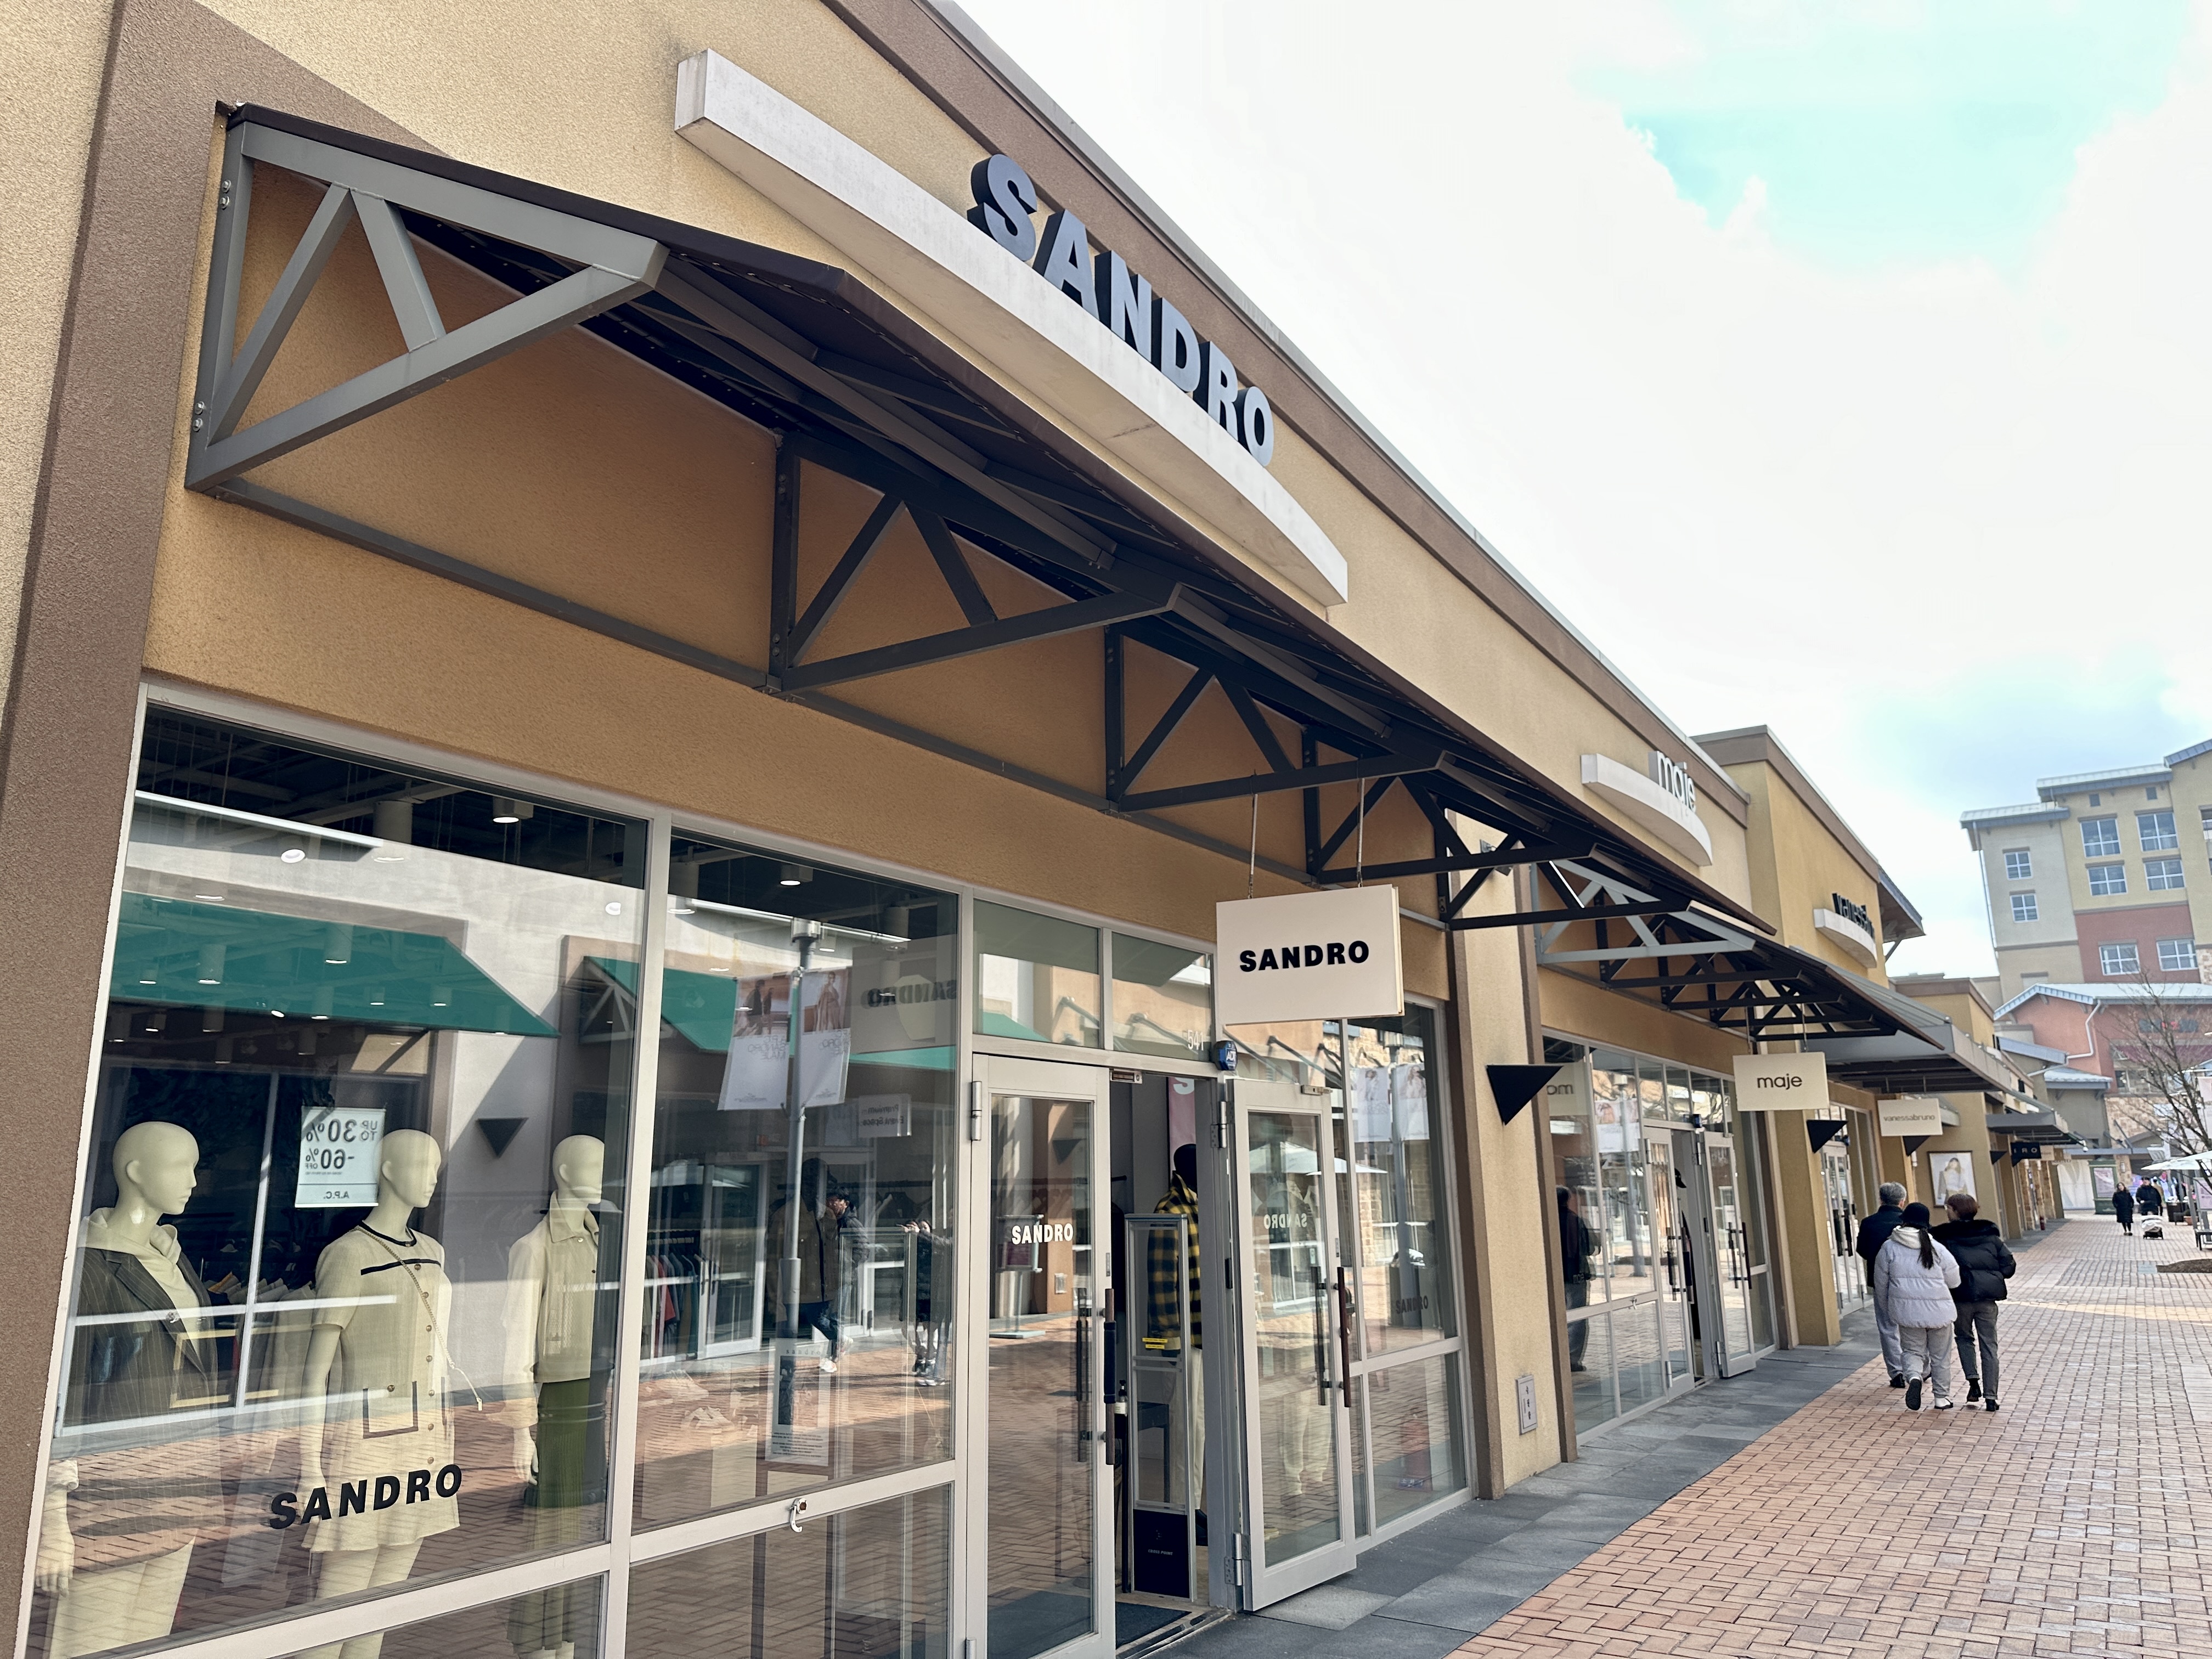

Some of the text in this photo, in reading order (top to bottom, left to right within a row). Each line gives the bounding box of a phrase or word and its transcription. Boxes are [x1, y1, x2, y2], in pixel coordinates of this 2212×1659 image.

[969, 154, 1274, 467] SANDRO
[1651, 751, 1696, 813] maje
[1239, 940, 1369, 972] SANDRO
[1187, 1029, 1204, 1051] 541
[1757, 1074, 1803, 1090] maje
[1883, 1114, 1936, 1122] vanessabruno
[1012, 1223, 1074, 1245] SANDRO
[269, 1464, 462, 1530] SANDRO
